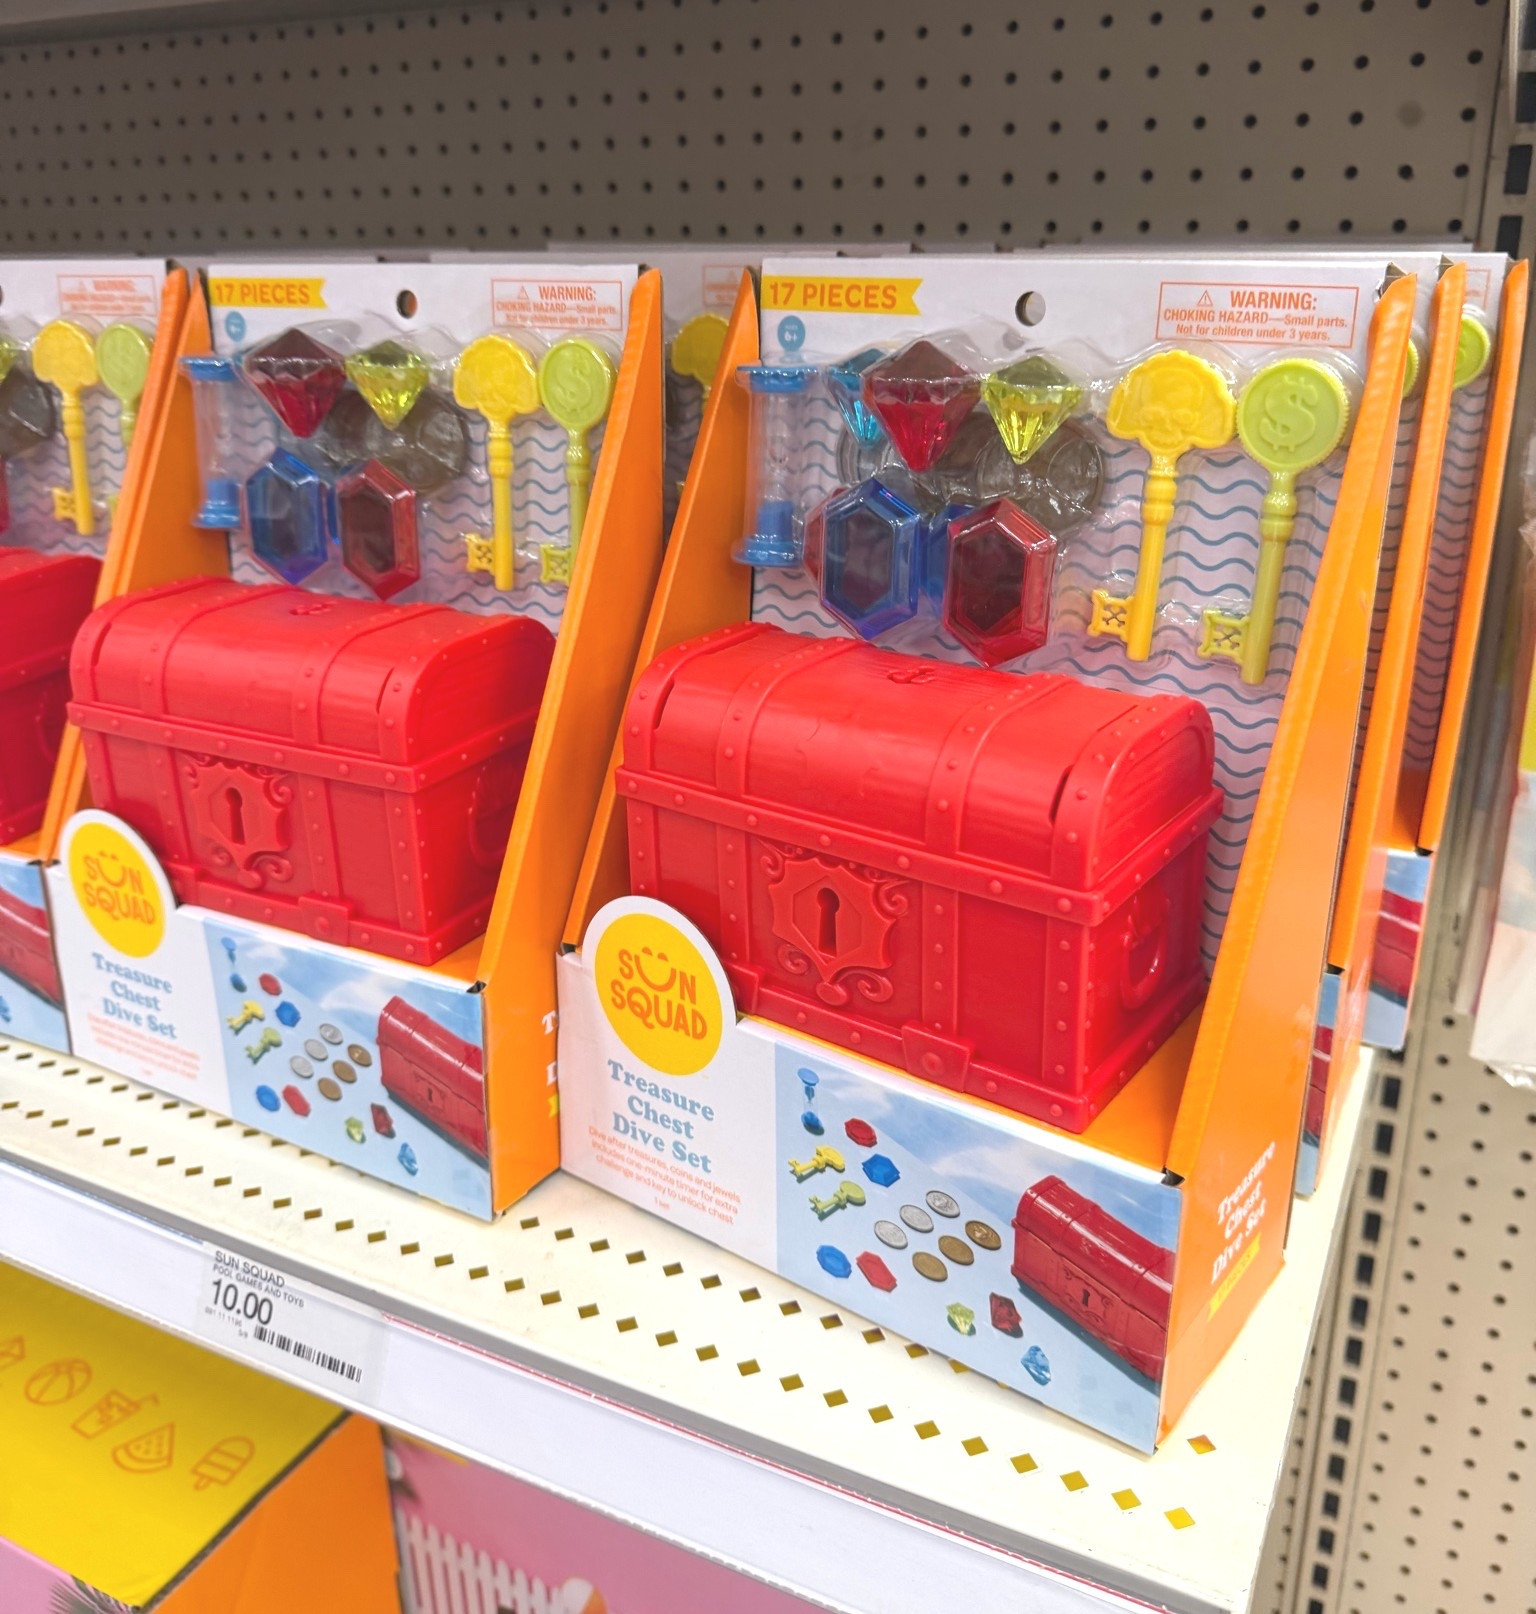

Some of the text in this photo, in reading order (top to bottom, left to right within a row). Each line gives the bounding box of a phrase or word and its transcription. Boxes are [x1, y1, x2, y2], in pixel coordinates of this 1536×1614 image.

[215, 283, 310, 305] 17 PIECES
[538, 286, 596, 301] WARNING:
[770, 282, 897, 310] 17 PIECES
[1230, 290, 1318, 310] WARNING:
[784, 330, 798, 342] 6+
[1164, 308, 1215, 322] CHOKING
[1316, 316, 1348, 330] parts.
[1176, 324, 1330, 342] Not for children under 3 years.
[83, 853, 144, 895] SUN
[82, 882, 156, 926] SQUAD
[92, 952, 173, 994] Treasure
[618, 948, 696, 1005] SUN
[110, 980, 162, 1012] Chest
[610, 979, 708, 1040] SQUAD
[102, 997, 178, 1040] Dive Set
[607, 1058, 715, 1121] Treasure
[627, 1095, 694, 1140] Chest
[607, 1134, 626, 1150] after
[628, 1144, 669, 1170] treasures,
[670, 1164, 694, 1182] coins
[694, 1176, 712, 1190] and
[612, 1112, 712, 1174] Dive Set
[596, 1154, 634, 1178] challenge
[635, 1171, 652, 1187] and
[652, 1177, 666, 1196] key
[667, 1186, 678, 1199] to
[678, 1192, 707, 1213] unlock
[626, 1154, 676, 1185] one-minute
[676, 1178, 700, 1198] timer
[700, 1189, 714, 1202] for
[714, 1198, 738, 1214] extra
[1217, 1141, 1276, 1225] Treasure
[1224, 1181, 1262, 1240] Chest
[214, 1250, 285, 1288] SUN SQUAD
[1210, 1232, 1243, 1285] Dive
[212, 1263, 304, 1308] POOL GAMES AND TOYS
[212, 1278, 274, 1325] 10.00
